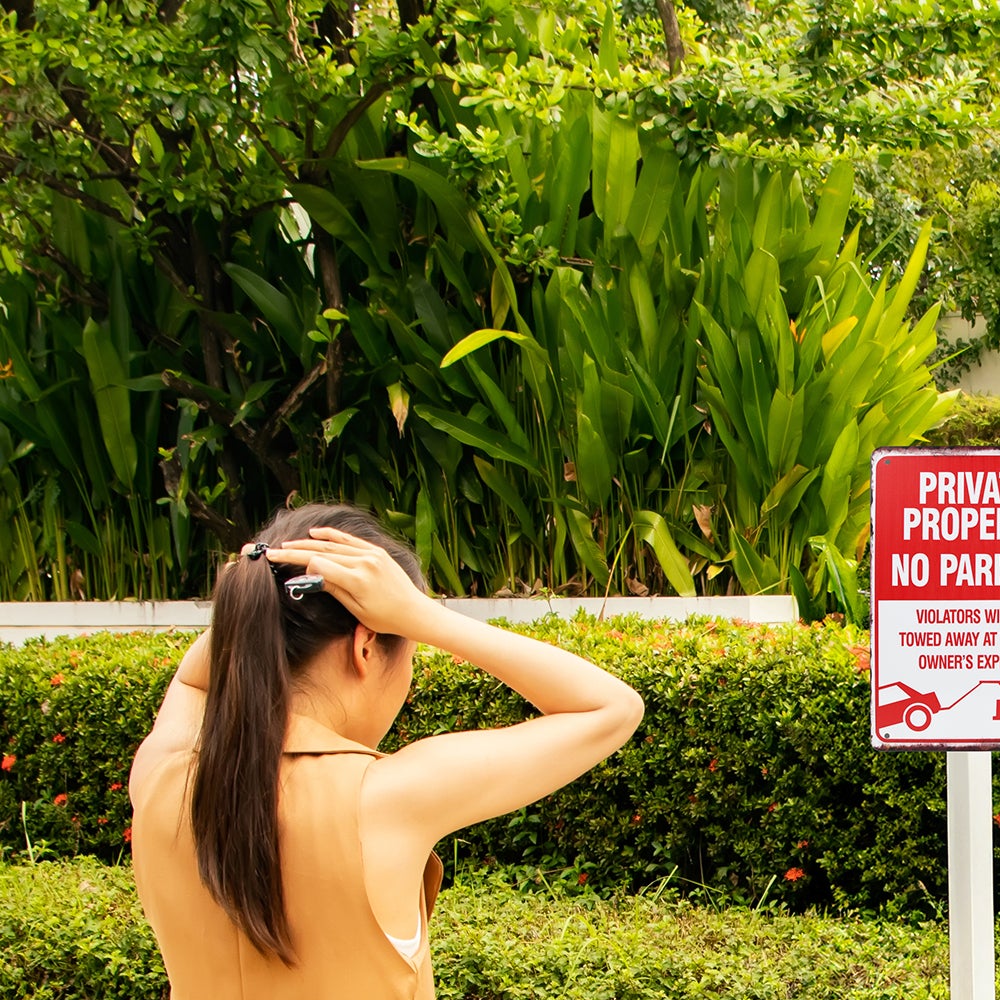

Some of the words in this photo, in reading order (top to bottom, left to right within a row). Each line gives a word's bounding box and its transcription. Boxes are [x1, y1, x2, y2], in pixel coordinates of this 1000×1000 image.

[891, 553, 930, 587] NO
[916, 609, 981, 624] VIOLATORS
[899, 632, 942, 647] TOWED
[945, 632, 980, 647] AWAY
[983, 632, 998, 647] AT
[918, 655, 974, 670] OWNER'S
